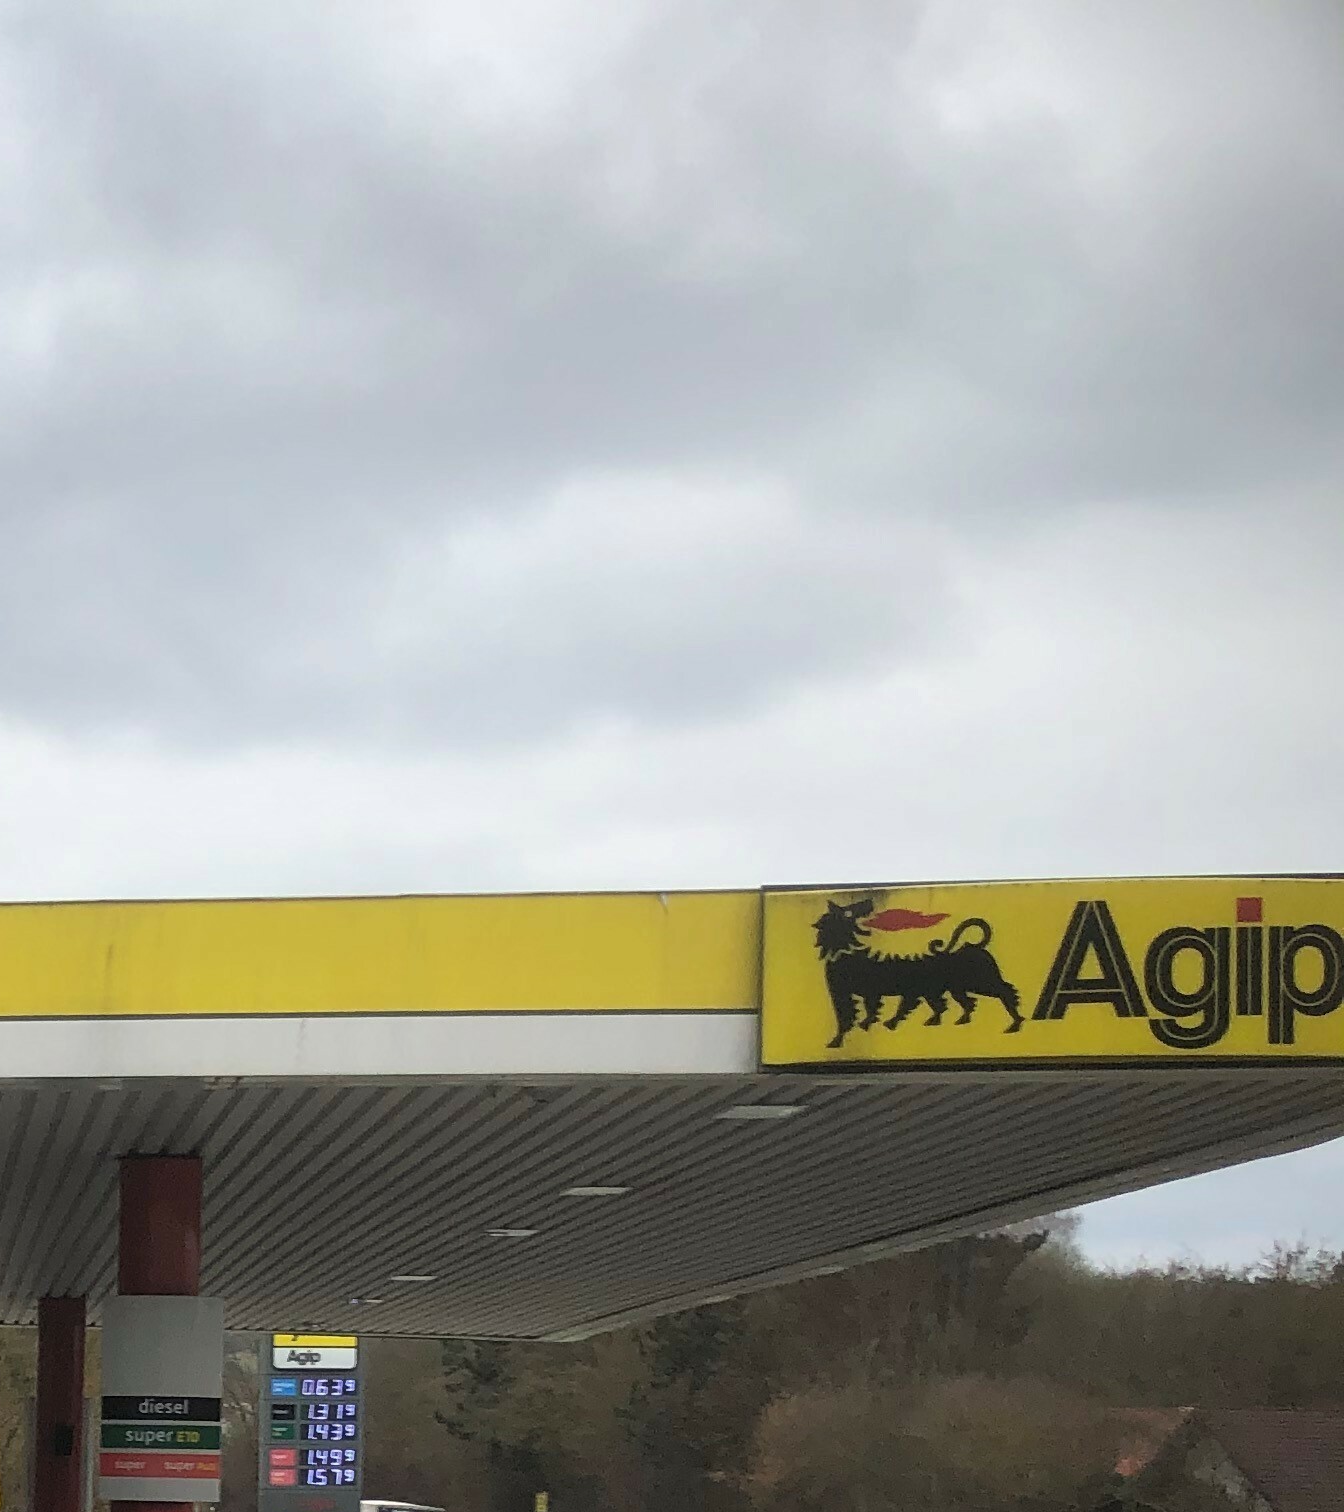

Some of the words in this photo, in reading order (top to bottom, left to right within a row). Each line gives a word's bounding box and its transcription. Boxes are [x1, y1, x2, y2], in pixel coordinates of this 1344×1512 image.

[1032, 897, 1344, 1048] Agip
[287, 1349, 321, 1365] Agip
[138, 1398, 189, 1414] diesel
[125, 1430, 173, 1445] super
[176, 1431, 200, 1443] E10
